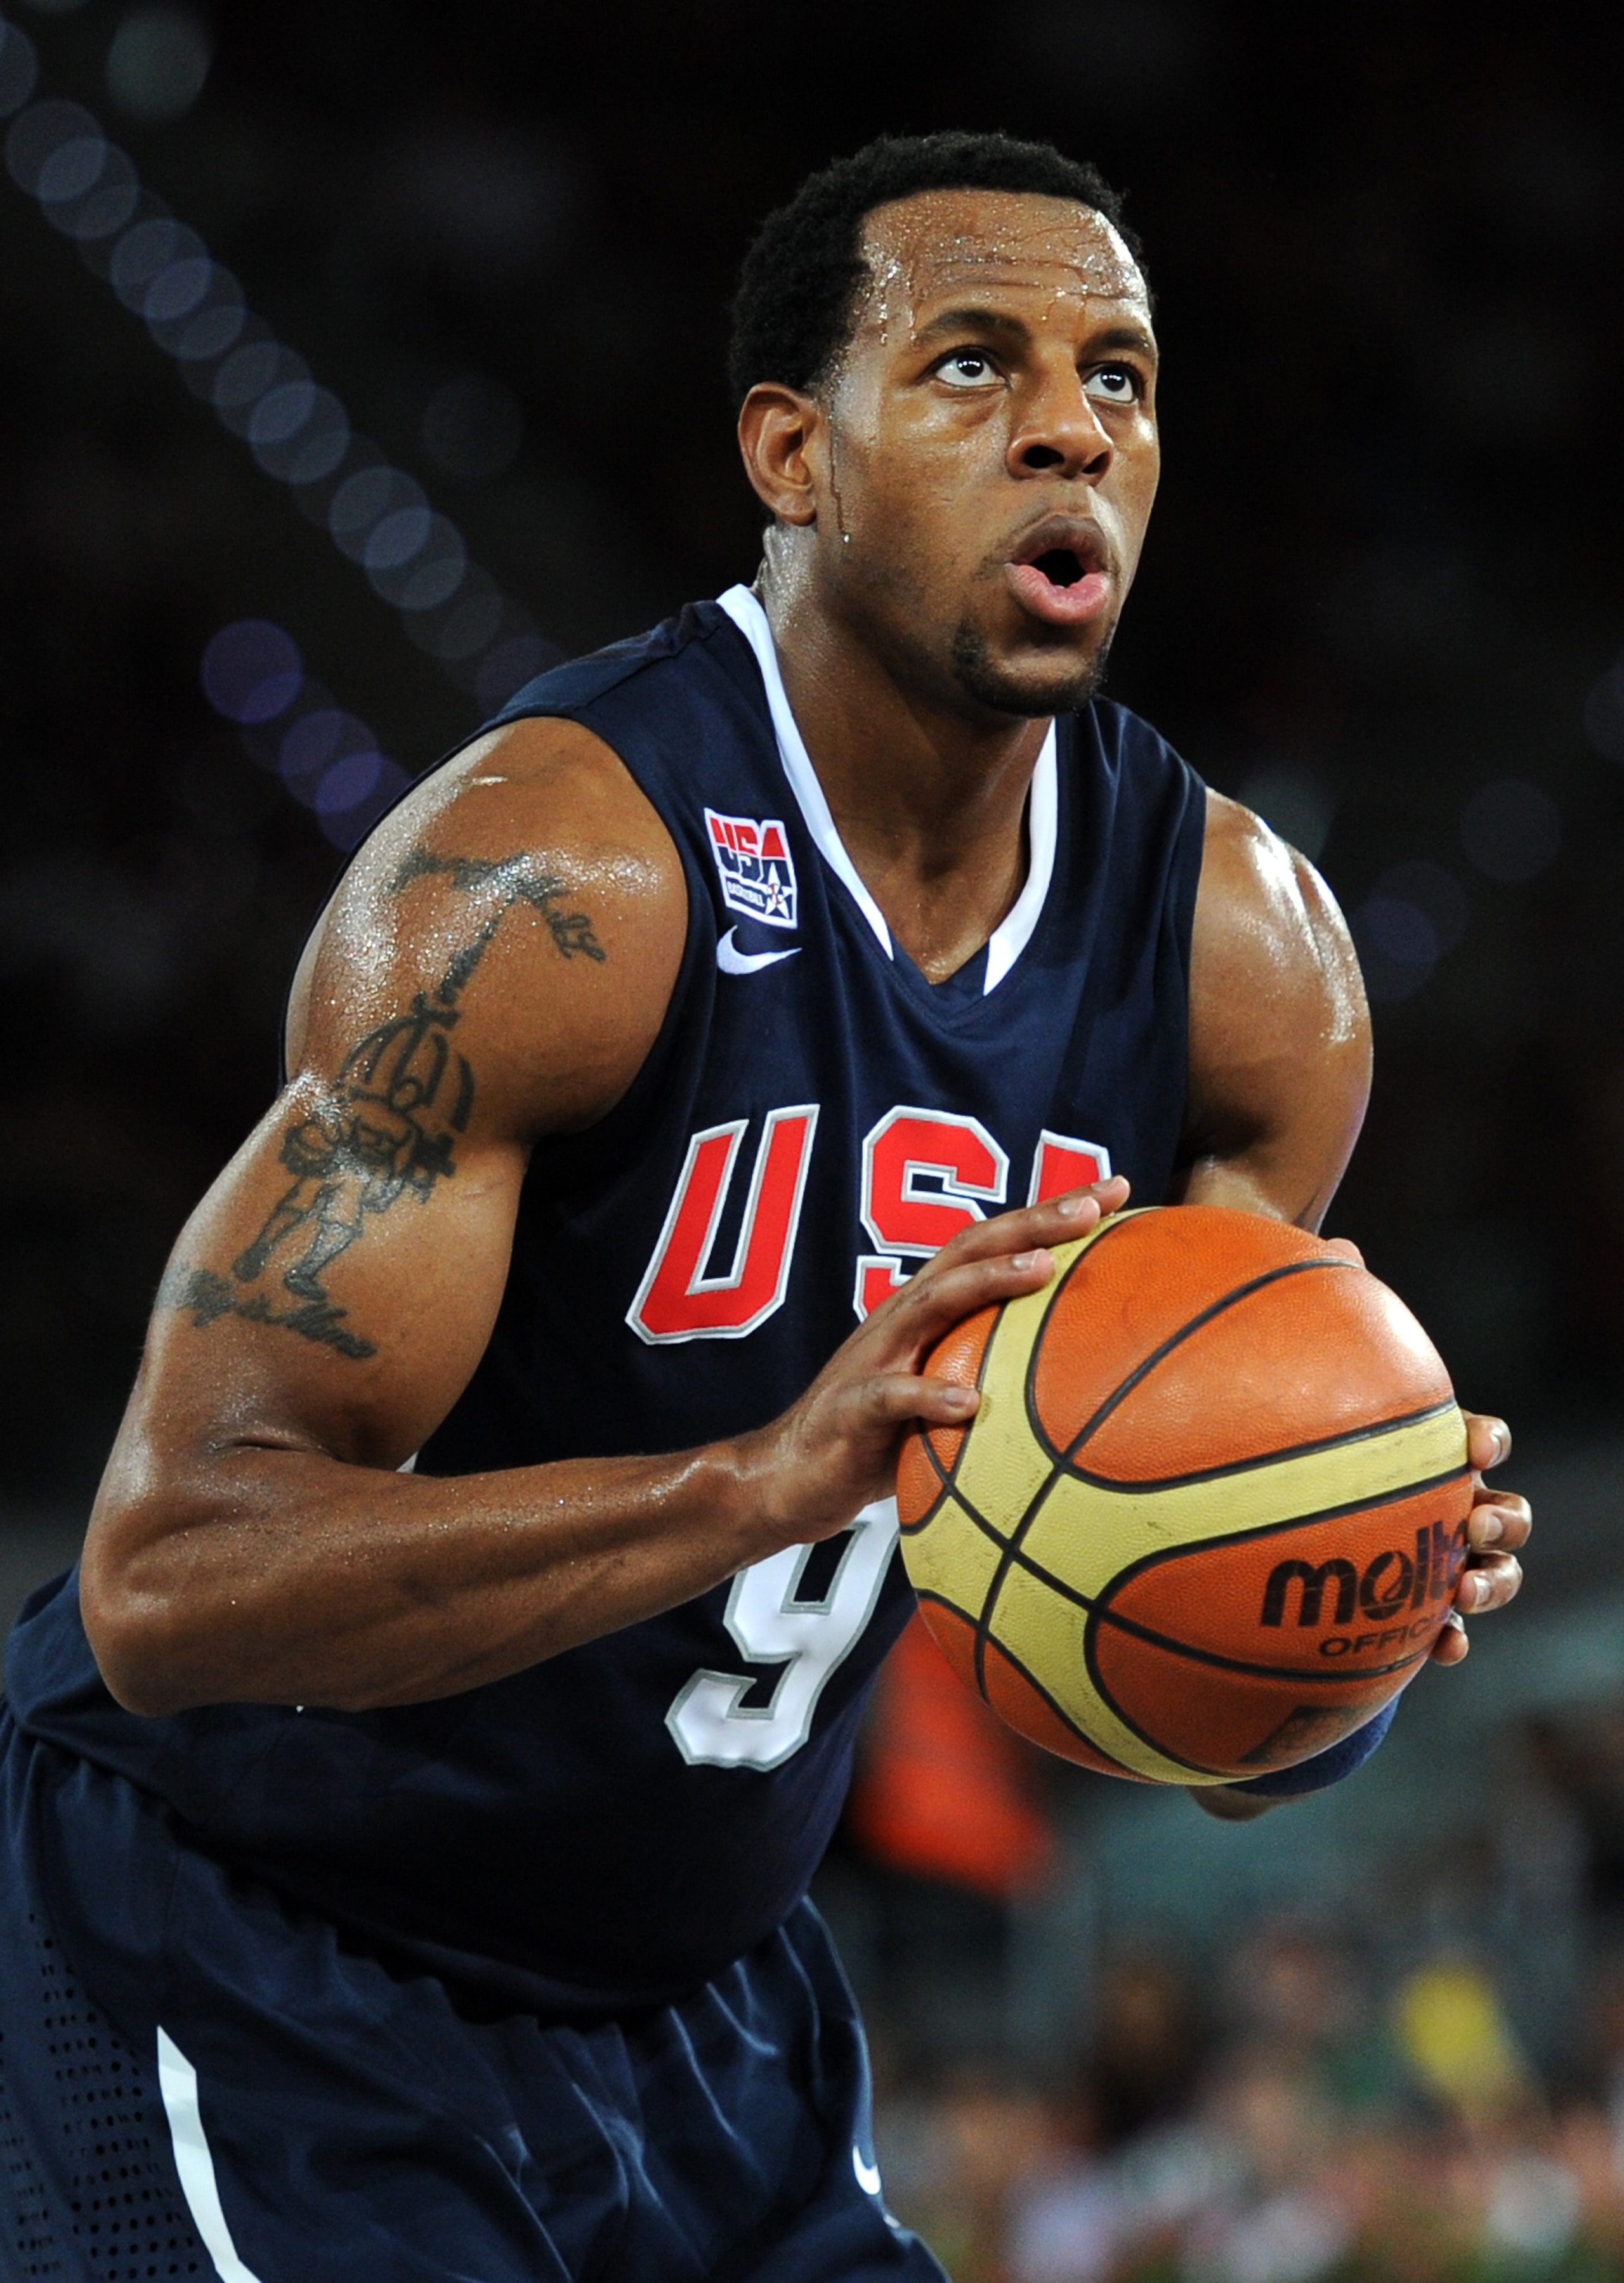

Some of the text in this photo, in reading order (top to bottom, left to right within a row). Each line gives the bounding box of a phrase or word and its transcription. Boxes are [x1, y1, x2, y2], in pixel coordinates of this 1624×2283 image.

[710, 817, 792, 887] USA
[1261, 1519, 1469, 1627] molte
[664, 1495, 900, 1772] 9
